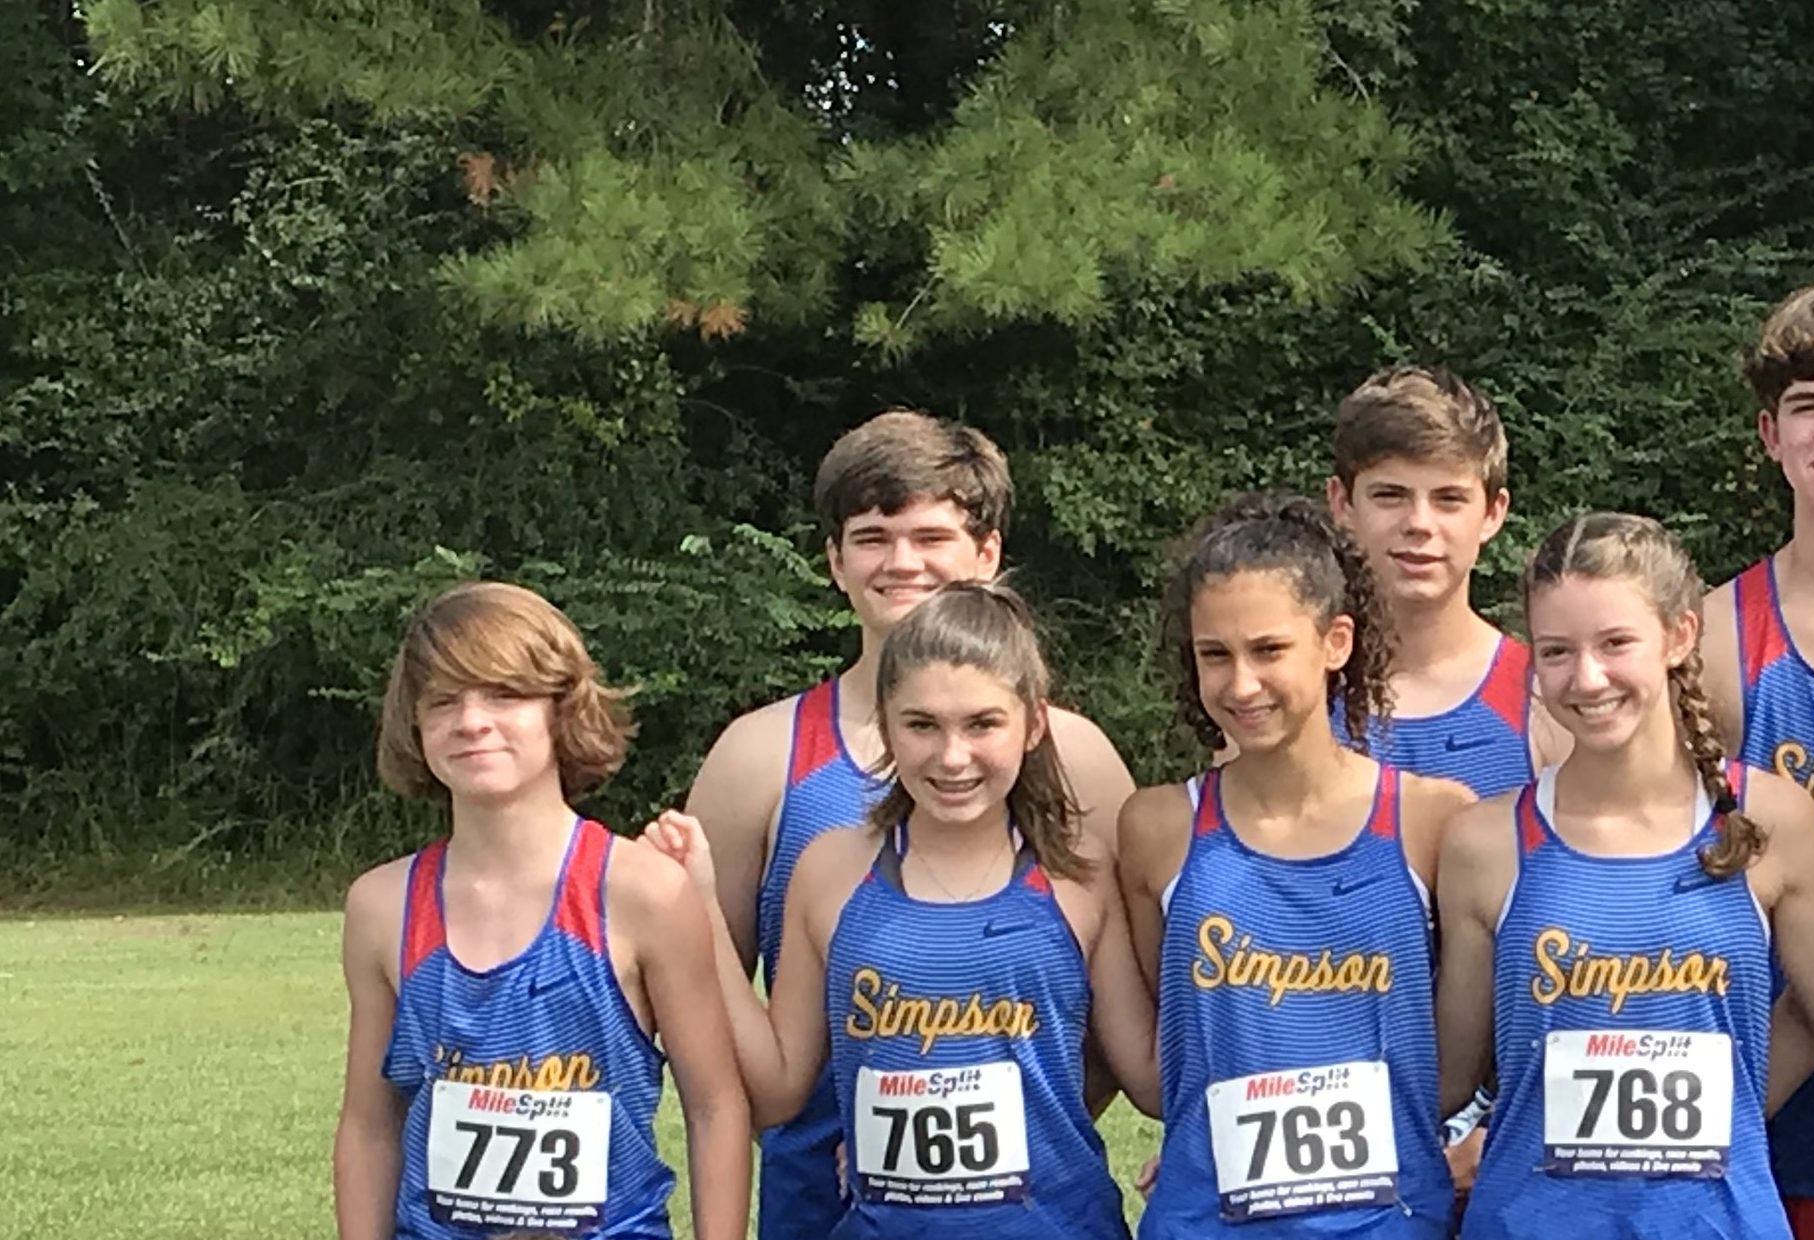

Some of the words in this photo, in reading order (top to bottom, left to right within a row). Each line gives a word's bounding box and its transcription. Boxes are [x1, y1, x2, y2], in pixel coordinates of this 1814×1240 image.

[1192, 914, 1393, 1007] Simpson
[1531, 926, 1730, 1015] Simpson
[846, 967, 1040, 1055] Simpson
[433, 1043, 600, 1091] impson
[878, 1070, 982, 1098] MileSplit
[1585, 1034, 1692, 1062] MileSplit
[468, 1088, 572, 1120] MileSplit
[1246, 1068, 1350, 1101] MileSplit
[1572, 1068, 1702, 1140] 768
[455, 1121, 580, 1198] 773
[872, 1102, 999, 1174] 765
[1236, 1101, 1370, 1182] 763
